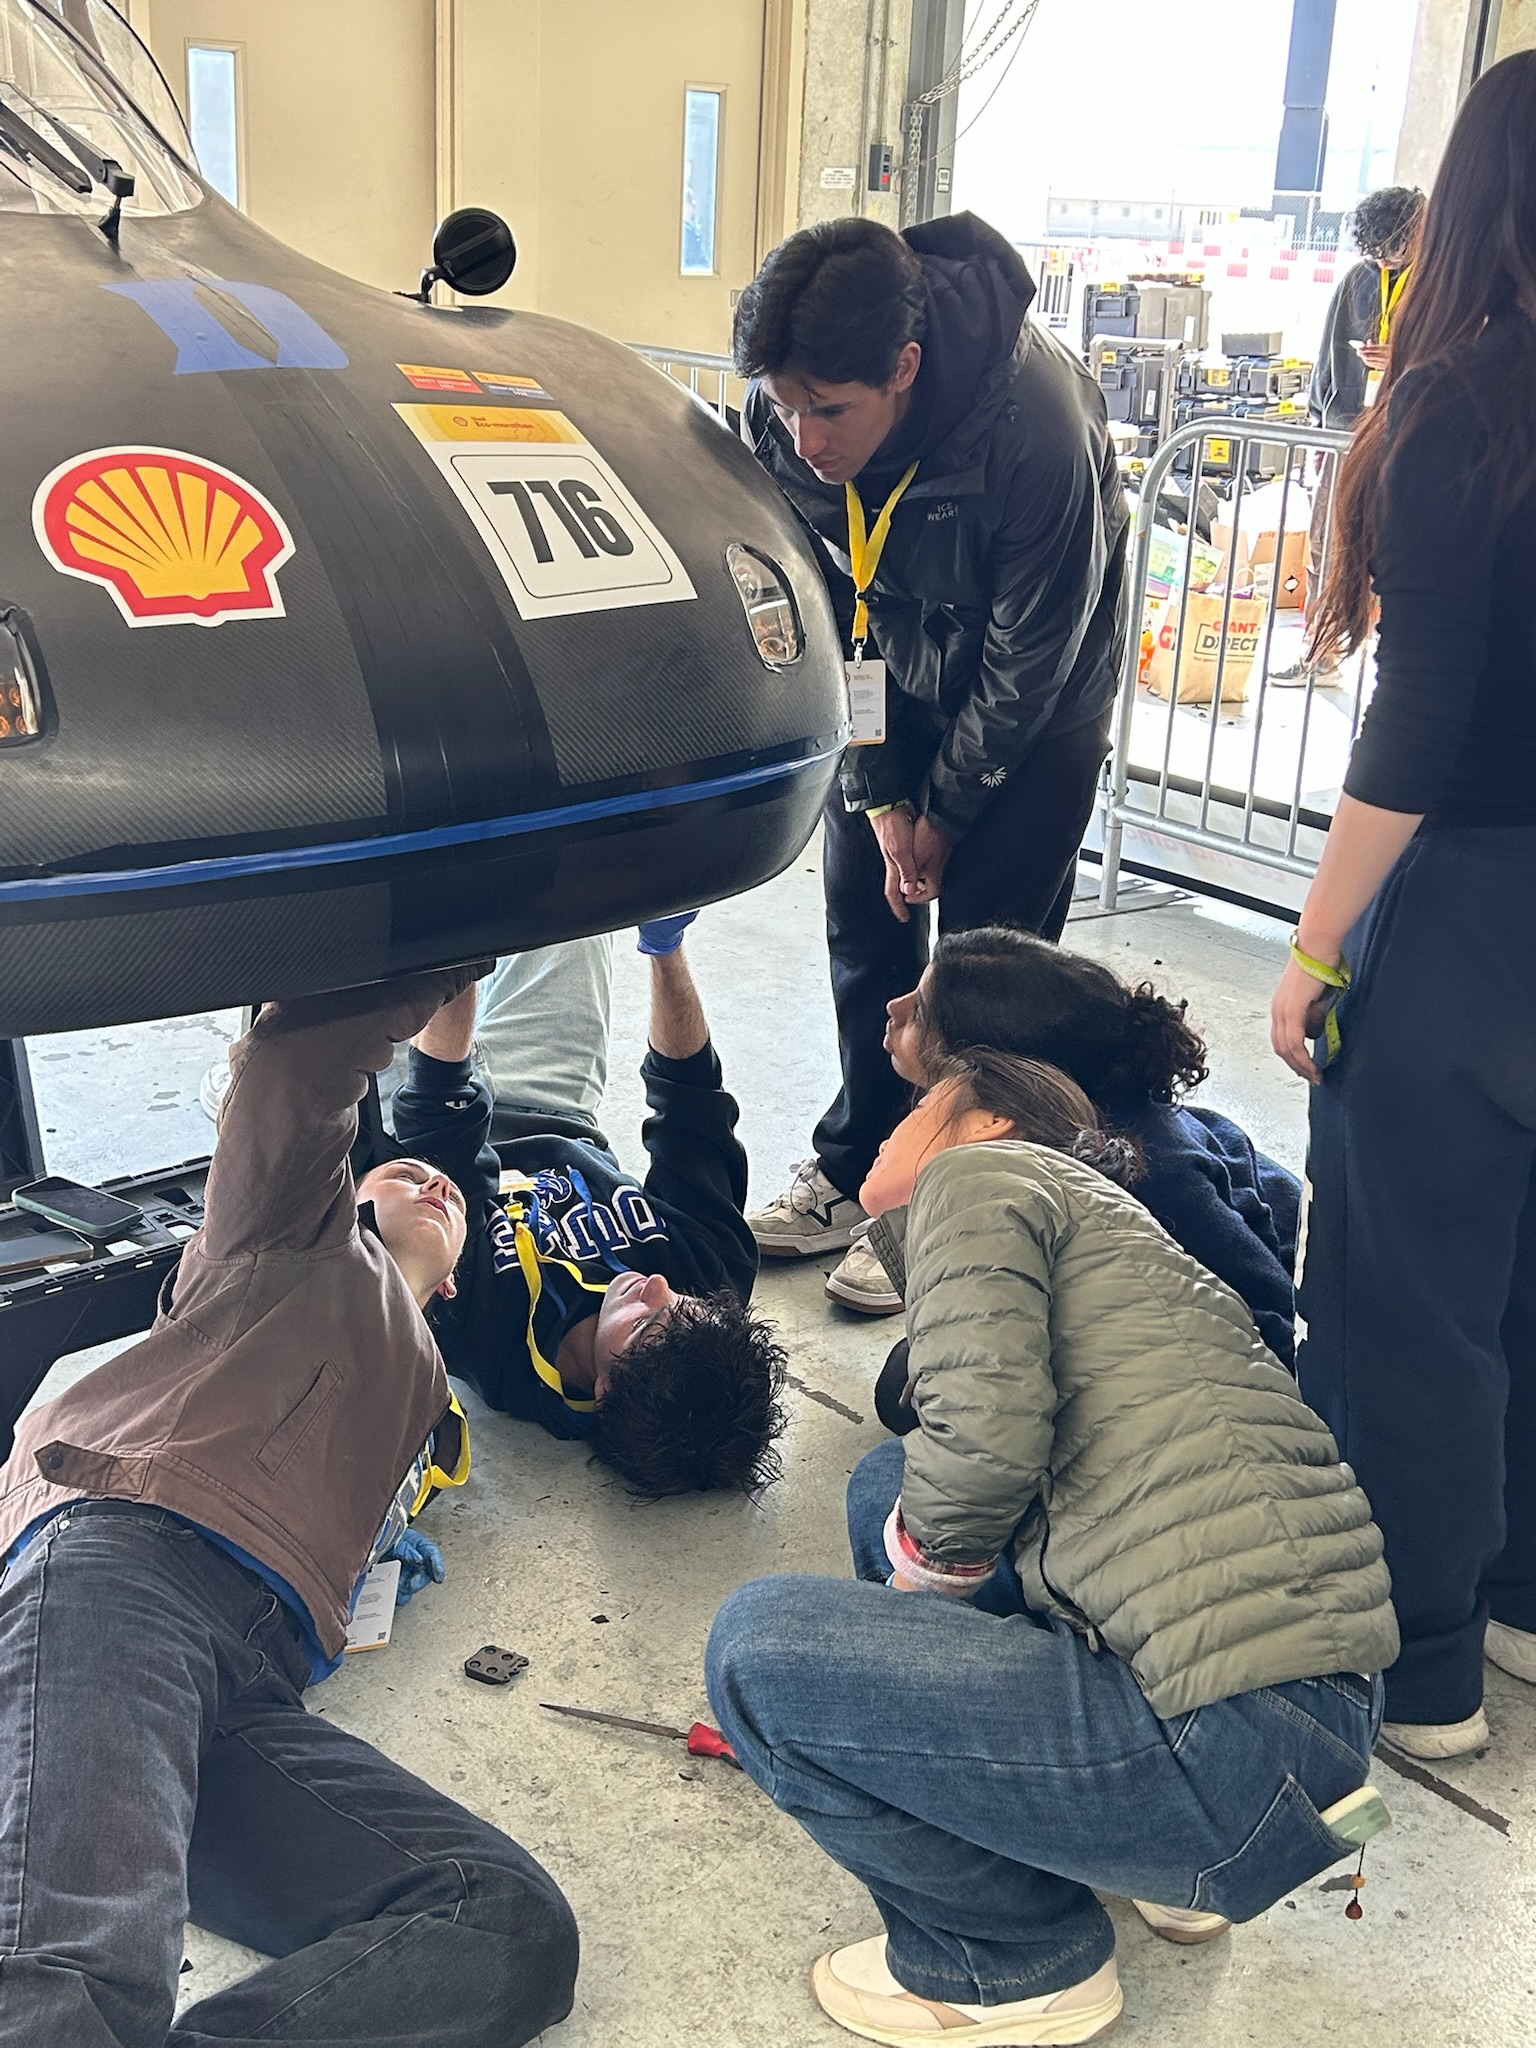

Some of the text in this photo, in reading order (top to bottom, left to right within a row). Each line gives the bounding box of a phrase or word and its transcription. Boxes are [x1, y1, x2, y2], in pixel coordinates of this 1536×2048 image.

[937, 501, 954, 513] ICE
[486, 479, 635, 564] 716
[927, 510, 955, 522] WEAR
[1212, 620, 1258, 634] GANT
[1202, 634, 1259, 652] DECT
